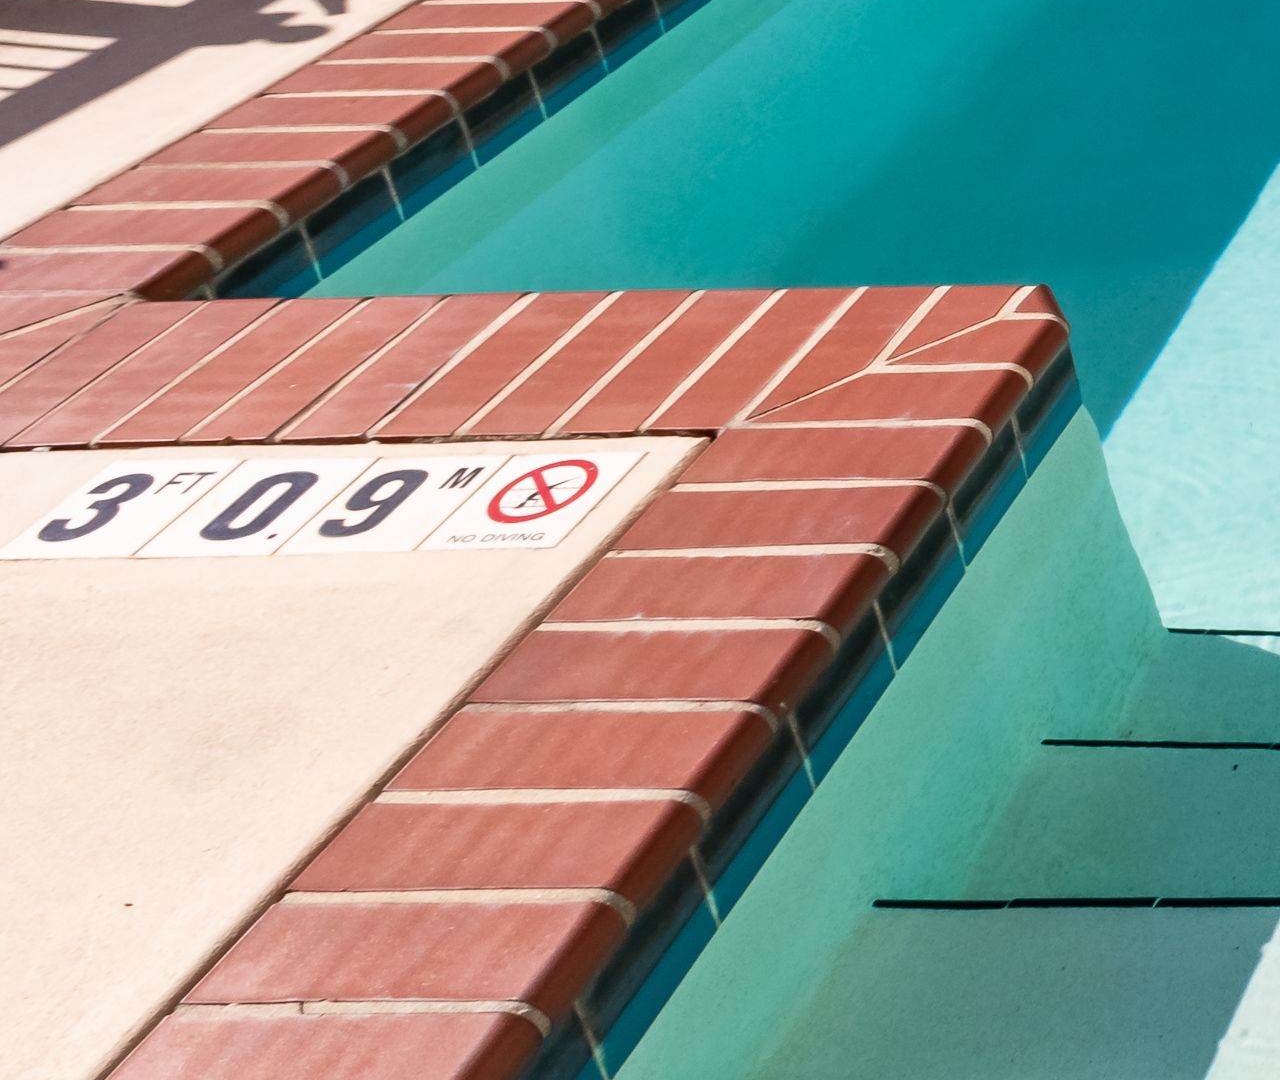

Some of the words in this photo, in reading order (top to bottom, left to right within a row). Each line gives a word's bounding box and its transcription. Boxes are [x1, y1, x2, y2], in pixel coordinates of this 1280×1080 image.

[37, 473, 155, 542] 3
[446, 534, 477, 544] NO
[479, 532, 546, 543] DIVING
